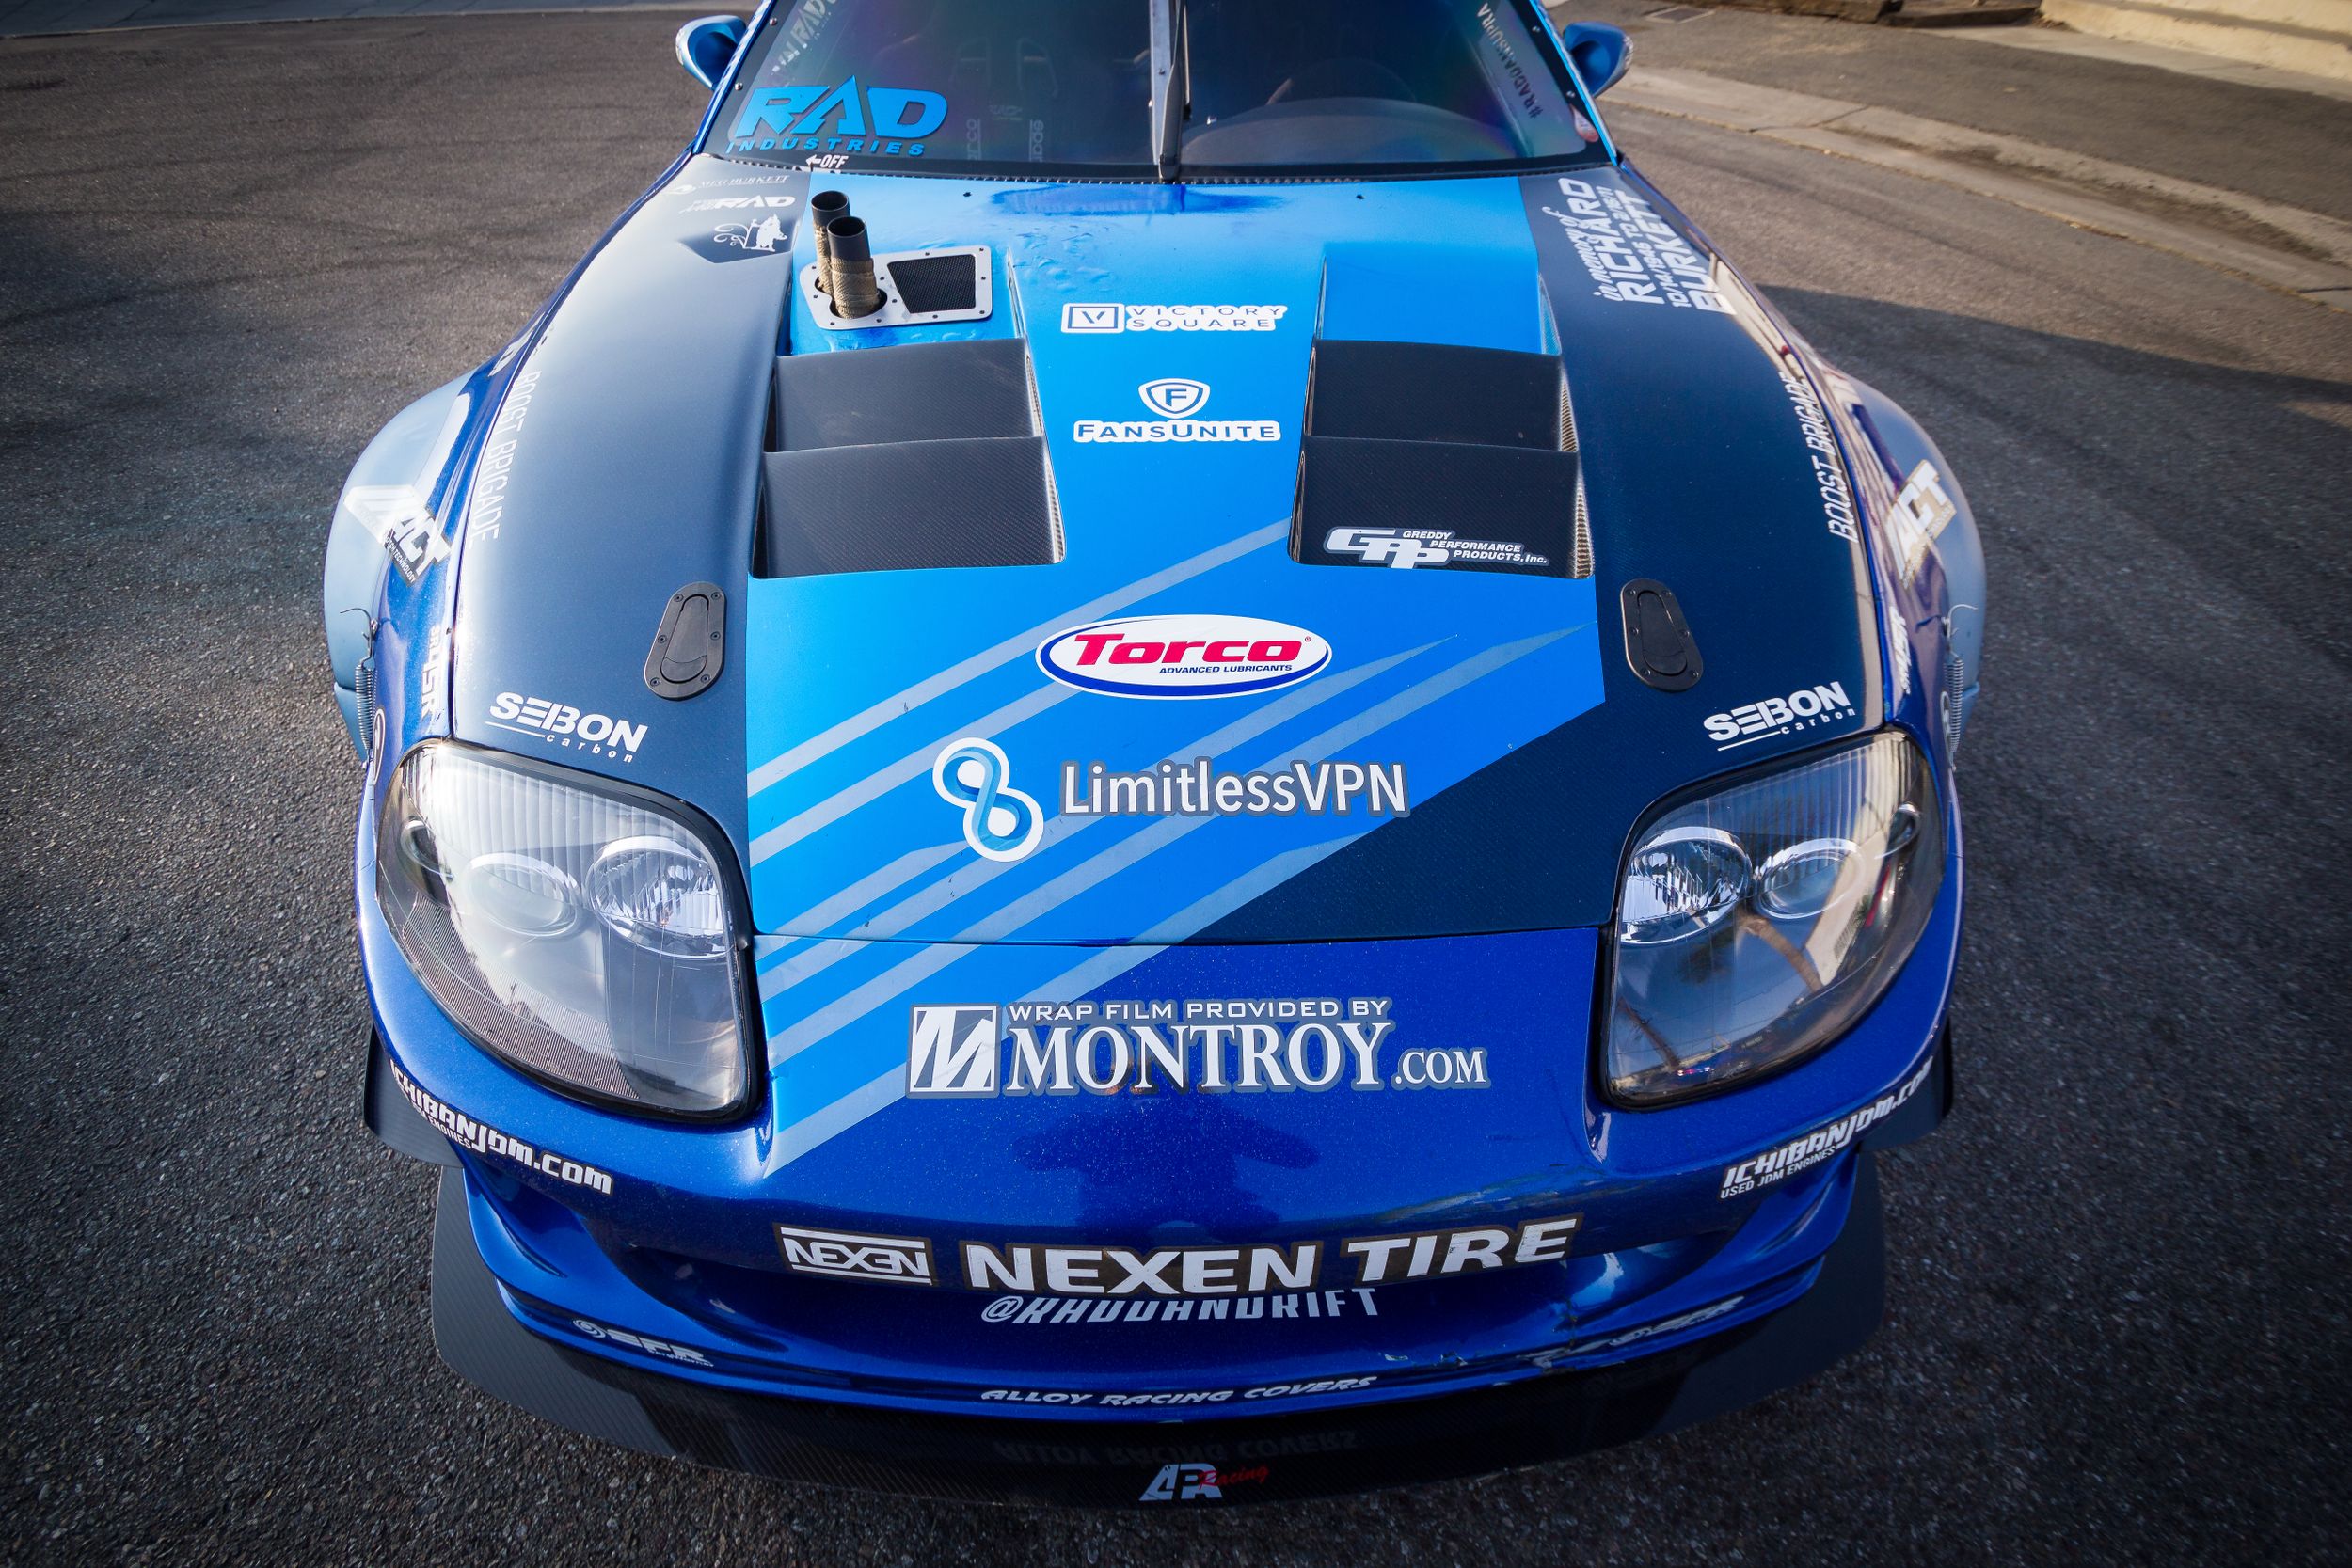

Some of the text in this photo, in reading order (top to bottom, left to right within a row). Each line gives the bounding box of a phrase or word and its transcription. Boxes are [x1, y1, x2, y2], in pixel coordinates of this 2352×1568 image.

[735, 75, 947, 138] RAD
[726, 136, 925, 156] INDUSTRIES
[820, 154, 848, 168] OFF
[714, 195, 795, 208] RAD
[1558, 177, 1665, 304] RICHARD
[1619, 222, 1643, 238] TO
[1614, 190, 1737, 315] BURKETT
[1132, 308, 1280, 316] VICTORY
[1132, 319, 1269, 328] SQUARE
[1077, 424, 1275, 438] FANSUNITE
[469, 371, 542, 550] BOOST BRIGADE
[1778, 372, 1859, 544] BOOST BRIGADE
[1403, 530, 1452, 540] GREDDY
[1429, 540, 1522, 553] PERFORMANCE
[1453, 549, 1548, 564] PRODUCTS, Inc.
[1074, 633, 1303, 666] Torco
[1158, 663, 1293, 674] ADVANCED LUBRICANTS
[489, 691, 648, 752] SEBON
[1703, 681, 1851, 741] SEBON
[1781, 707, 1856, 735] carbon
[546, 734, 633, 763] carbon
[1064, 759, 1406, 813] LimitlessVPN
[1009, 999, 1389, 1022] WRAP FILM PROVIDED BY
[1720, 1145, 1836, 1199] USED JDM ENGINES
[782, 1237, 930, 1277] NEXEN
[966, 1218, 1578, 1294] NEXEN TIRE
[980, 1376, 1378, 1406] ALLOY RACING COVERS
[1198, 1464, 1270, 1491] Racing
